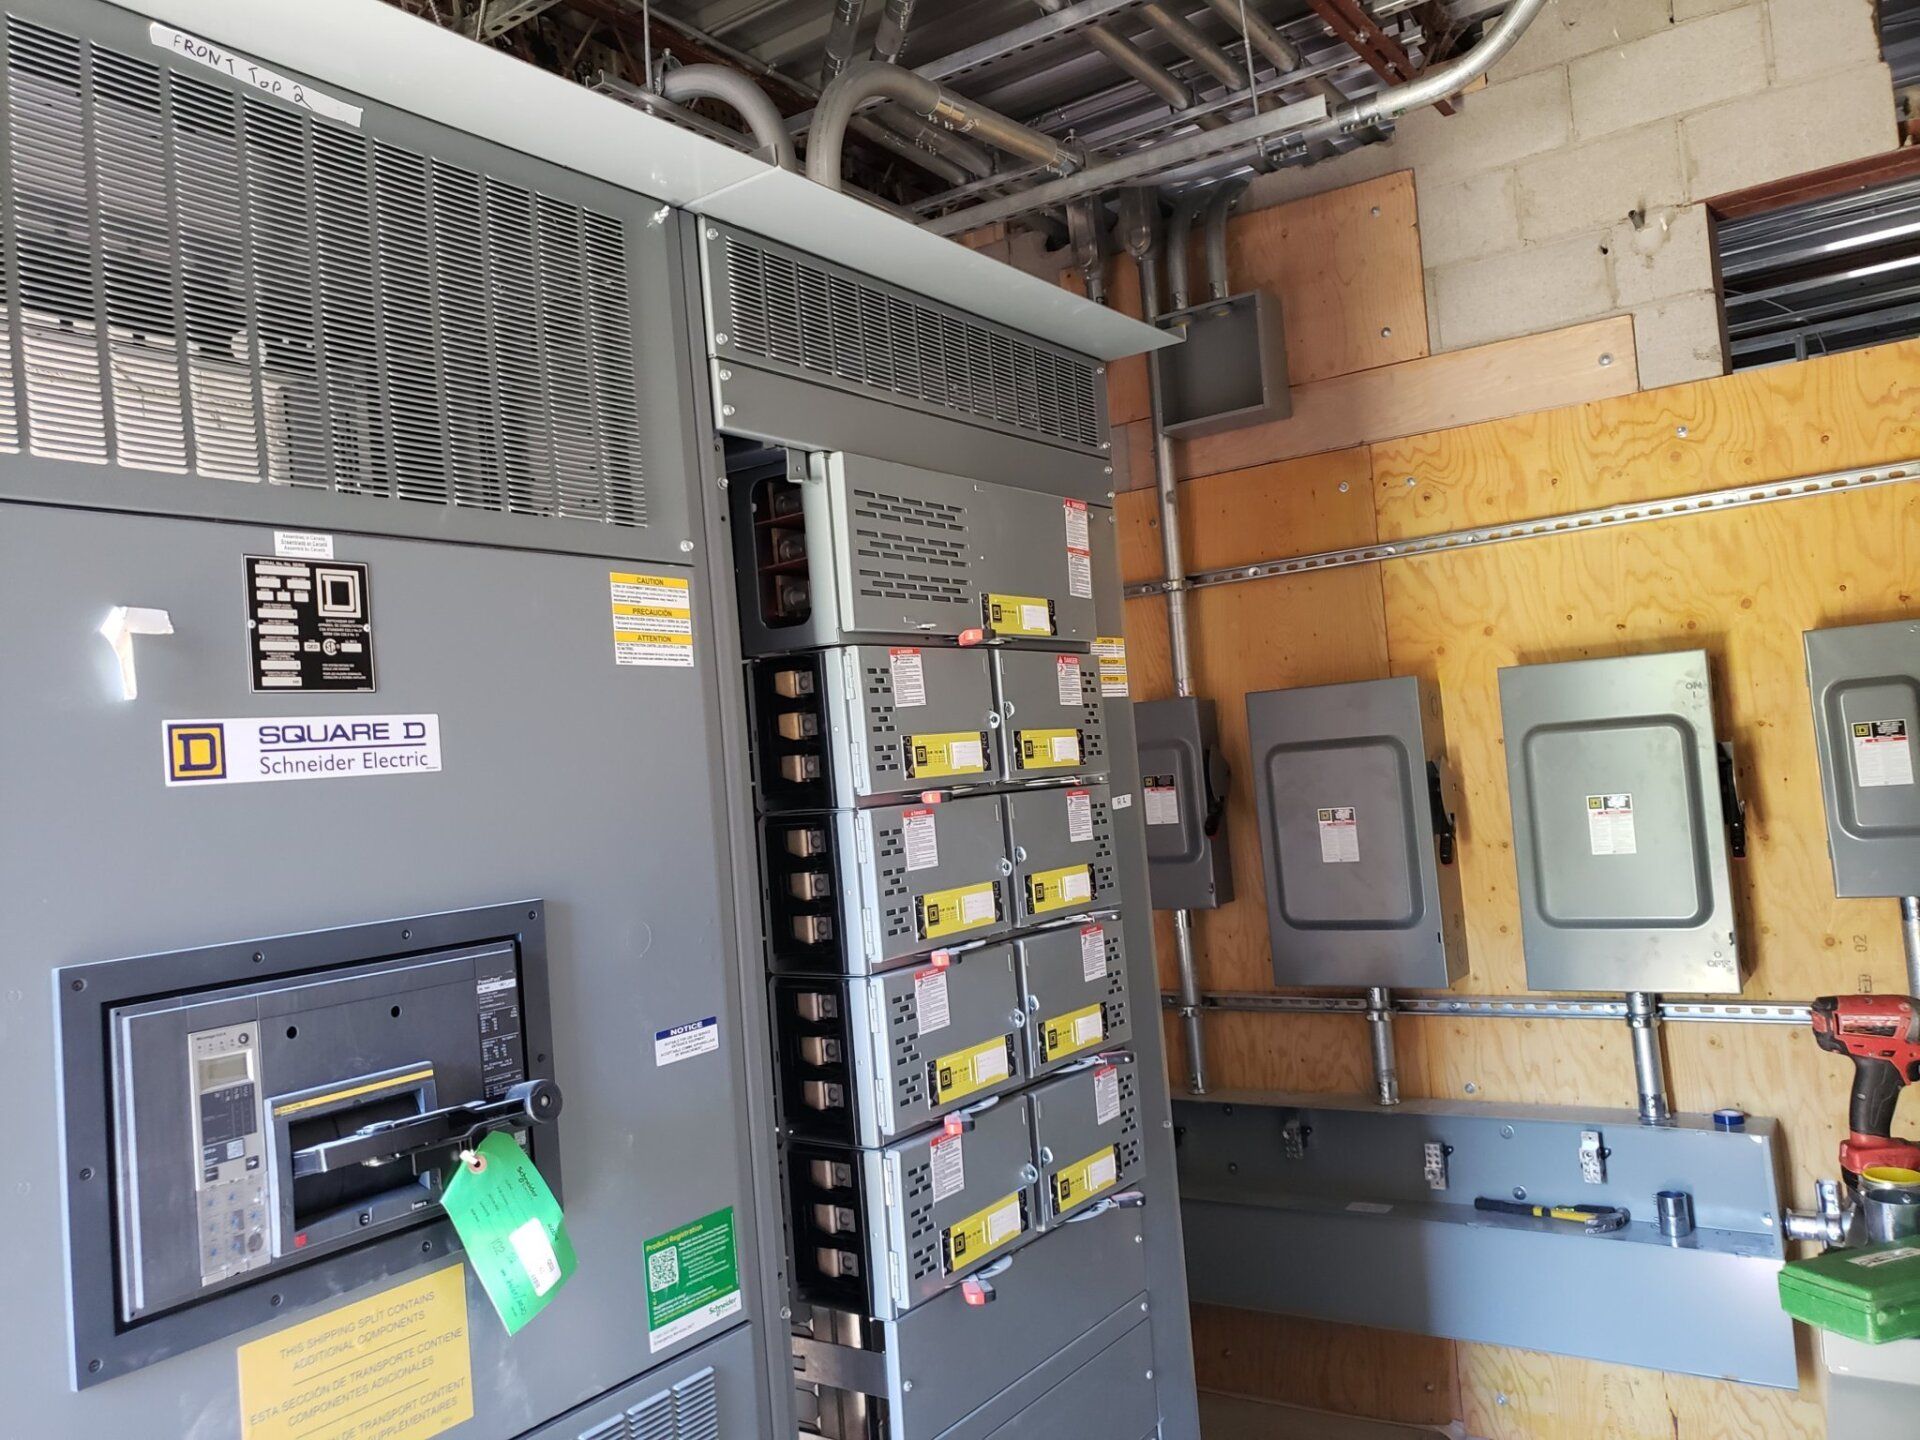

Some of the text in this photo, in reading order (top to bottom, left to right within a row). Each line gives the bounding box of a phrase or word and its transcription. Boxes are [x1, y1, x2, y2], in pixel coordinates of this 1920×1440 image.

[174, 35, 234, 75] FRONT
[293, 85, 314, 110] 2
[636, 577, 664, 586] CAUTION
[632, 607, 673, 617] PRECAUCIÓN
[637, 634, 672, 643] ATTENTION
[259, 723, 390, 744] SQUARE
[403, 721, 426, 740] D
[260, 750, 429, 775] Schneider Electric
[670, 1021, 703, 1035] NOTICE
[516, 1166, 538, 1197] Schneider
[280, 1291, 435, 1360] THIS SHIPPING SPLIT CONTAINS
[293, 1310, 426, 1371] ADDITIONAL COMPONENTS
[250, 1328, 464, 1426] ESTA SECCIÓN DE TRANSPORTE CONTIENE
[288, 1355, 435, 1427] COMPONENTES ADICIONALES
[359, 1398, 418, 1434] TRANSPORT
[420, 1379, 465, 1404] CONTIENT
